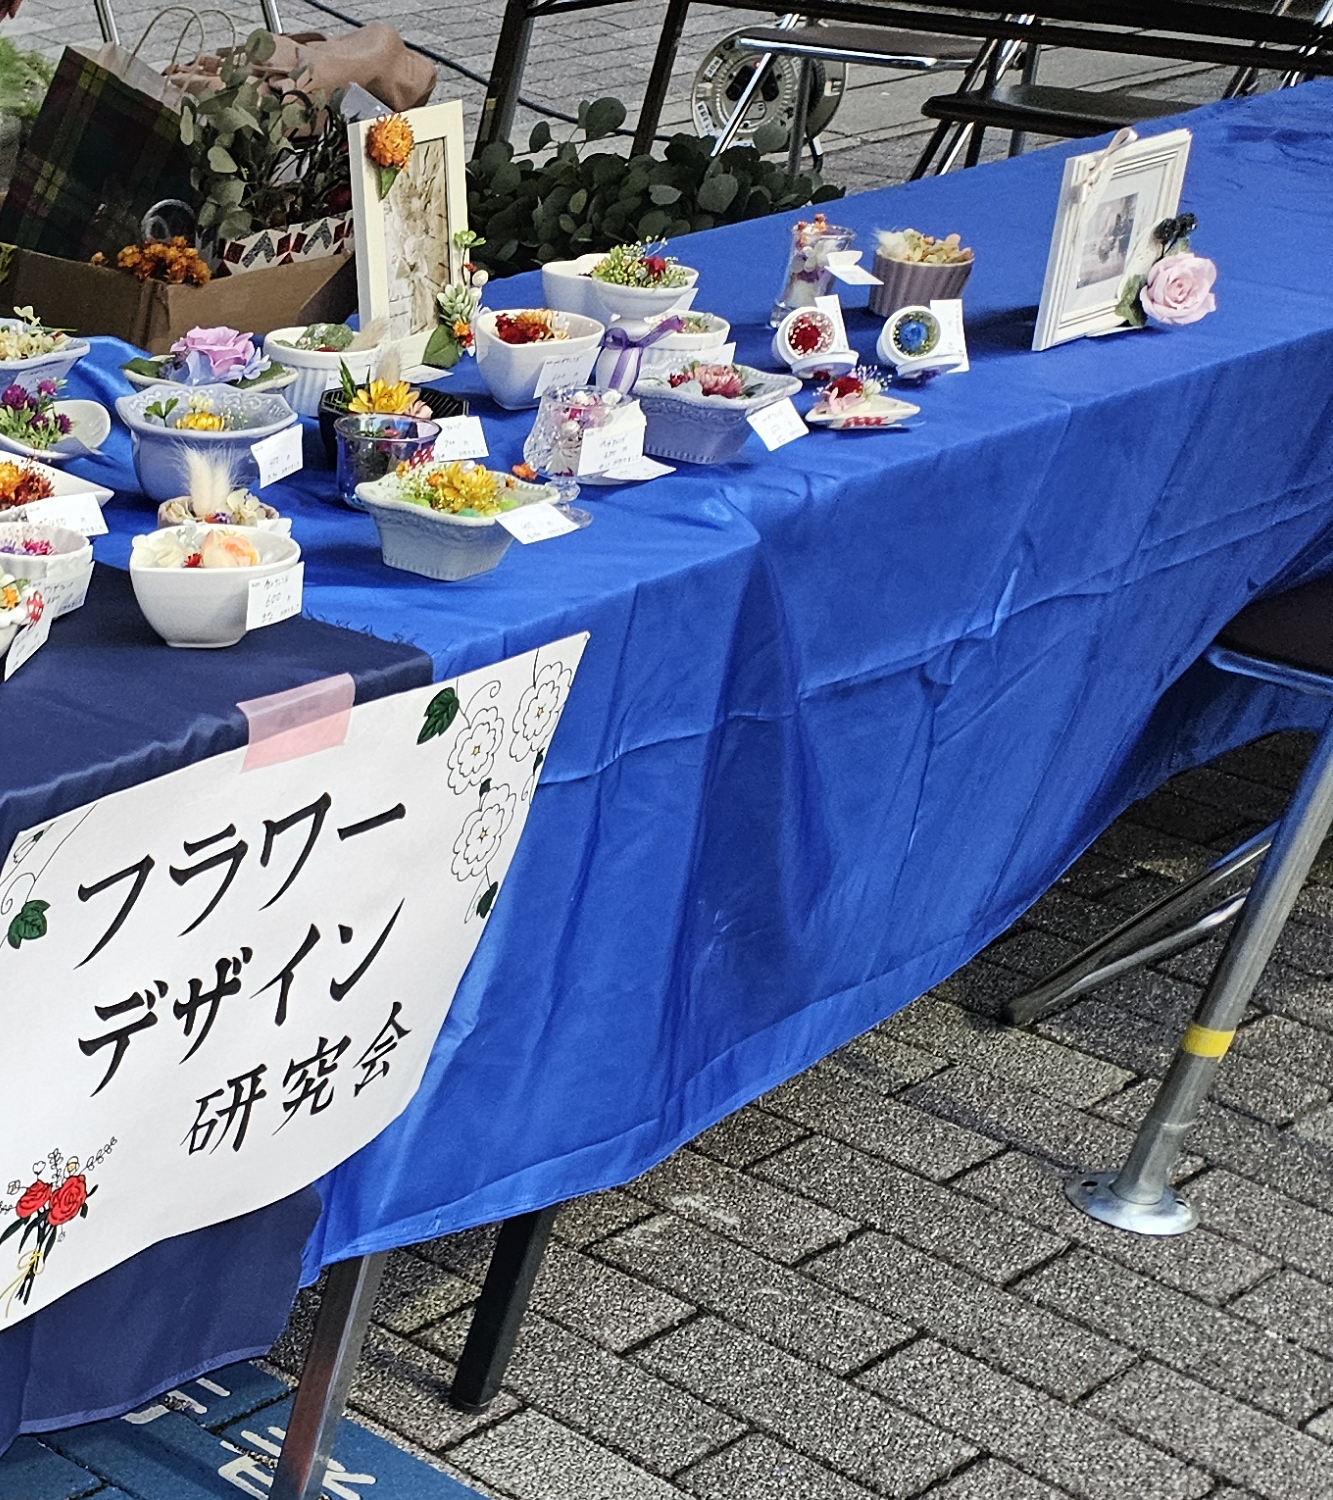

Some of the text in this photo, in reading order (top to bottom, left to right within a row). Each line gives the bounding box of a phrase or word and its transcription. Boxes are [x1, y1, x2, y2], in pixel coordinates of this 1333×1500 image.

[73, 792, 406, 970] フラワー
[78, 898, 406, 1098] デザイン
[180, 1002, 412, 1156] 研究会
